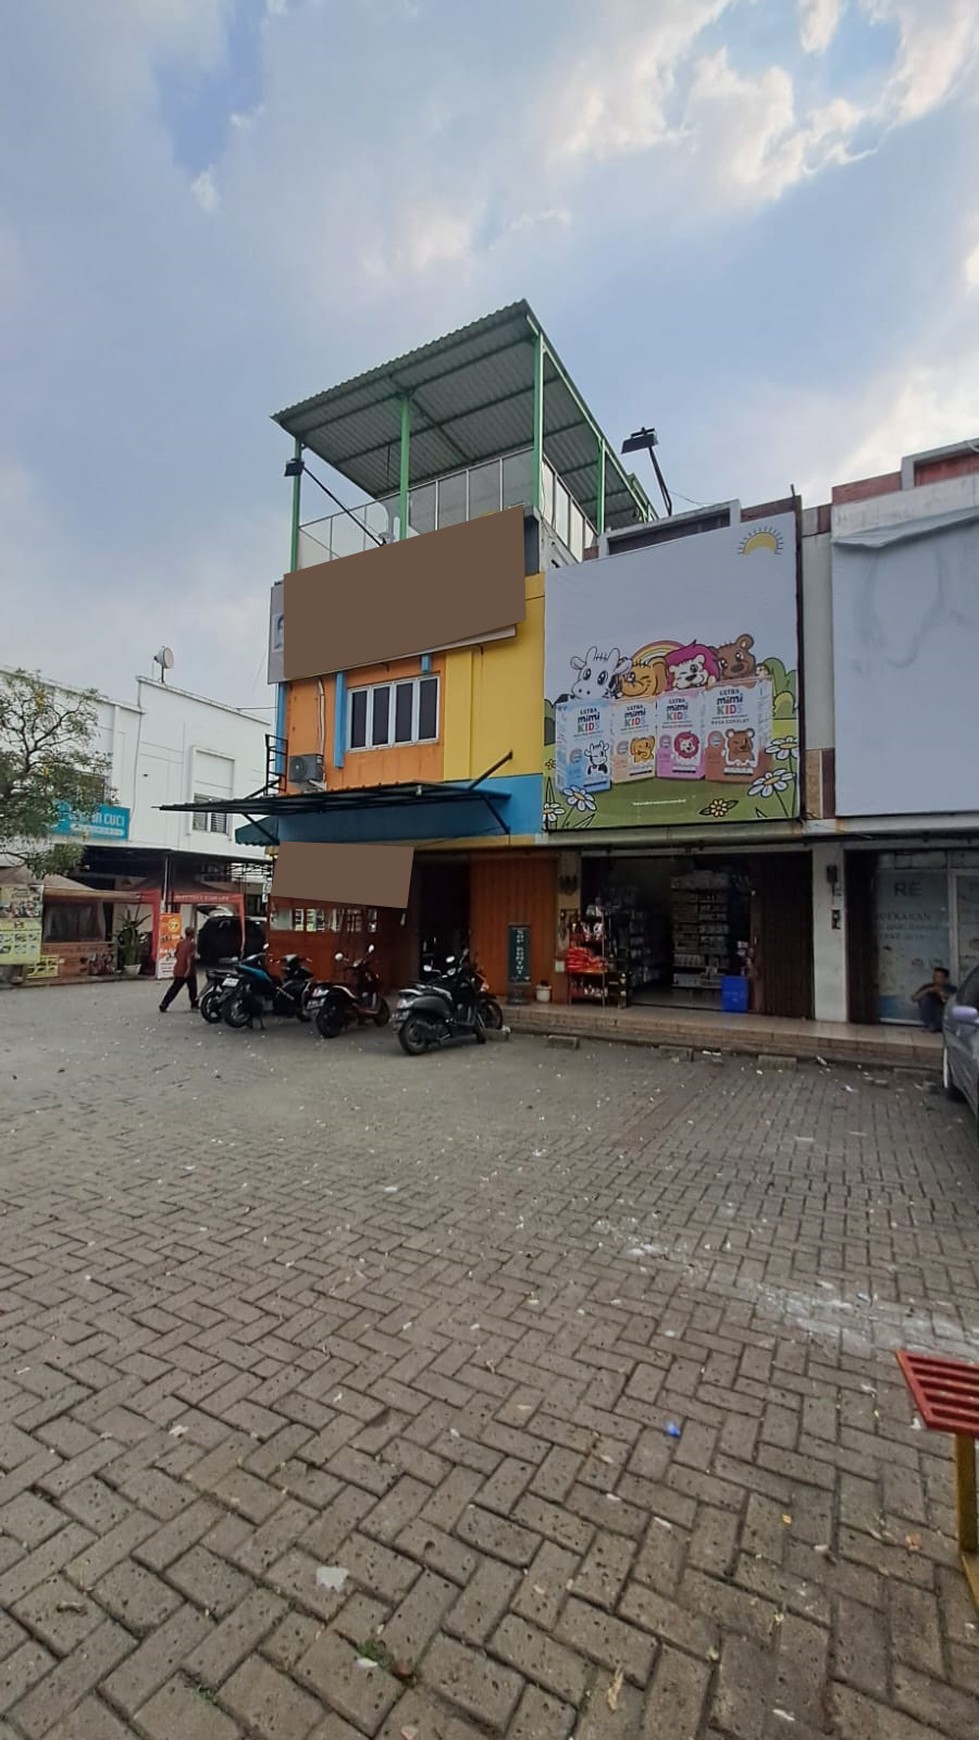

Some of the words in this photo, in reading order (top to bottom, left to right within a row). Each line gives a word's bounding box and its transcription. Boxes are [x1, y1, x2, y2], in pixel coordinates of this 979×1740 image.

[716, 693, 743, 705] mimi
[717, 703, 742, 715] KIDS
[667, 711, 688, 720] KIDS
[578, 722, 600, 732] KIDS
[624, 717, 645, 727] KIDS
[103, 813, 125, 827] CUCI
